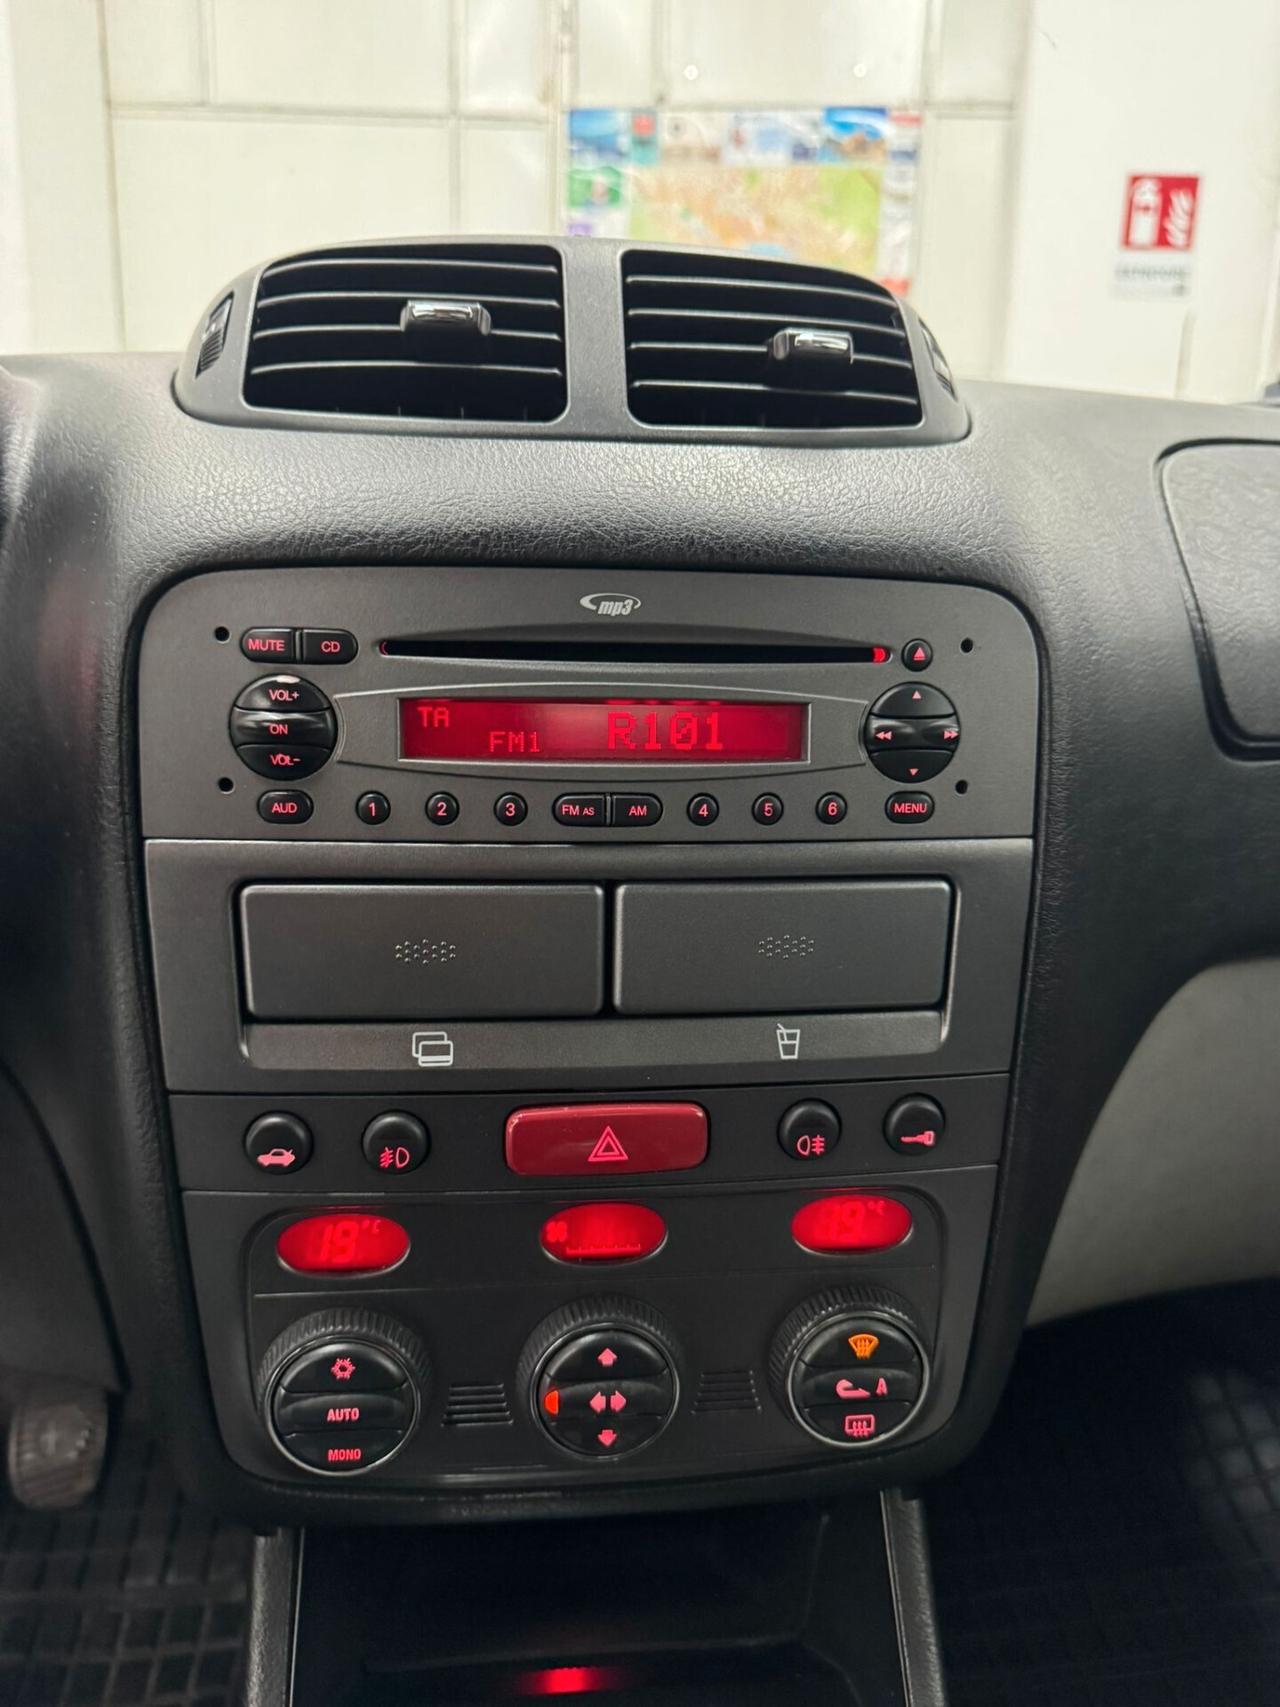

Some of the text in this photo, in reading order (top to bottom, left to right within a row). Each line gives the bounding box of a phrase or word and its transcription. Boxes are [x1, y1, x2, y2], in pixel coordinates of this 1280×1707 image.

[597, 598, 634, 618] mp3
[247, 638, 285, 652] MUTE
[321, 640, 341, 653] CD
[269, 689, 299, 701] VOL+
[417, 706, 450, 728] TA
[269, 723, 289, 735] ON
[607, 711, 724, 751] R101
[489, 730, 541, 753] FM1
[270, 753, 300, 766] VOL-
[271, 802, 298, 814] AUD
[368, 802, 376, 817] 1
[436, 802, 447, 817] 2
[505, 802, 515, 817] 3
[562, 804, 595, 817] FM AS
[628, 804, 648, 817] AM
[698, 802, 709, 817] 4
[763, 802, 773, 817] 5
[827, 802, 838, 816] 6
[893, 801, 928, 815] MENU
[875, 1377, 888, 1396] A
[326, 1406, 360, 1422] AUTO
[327, 1446, 362, 1463] MONO
